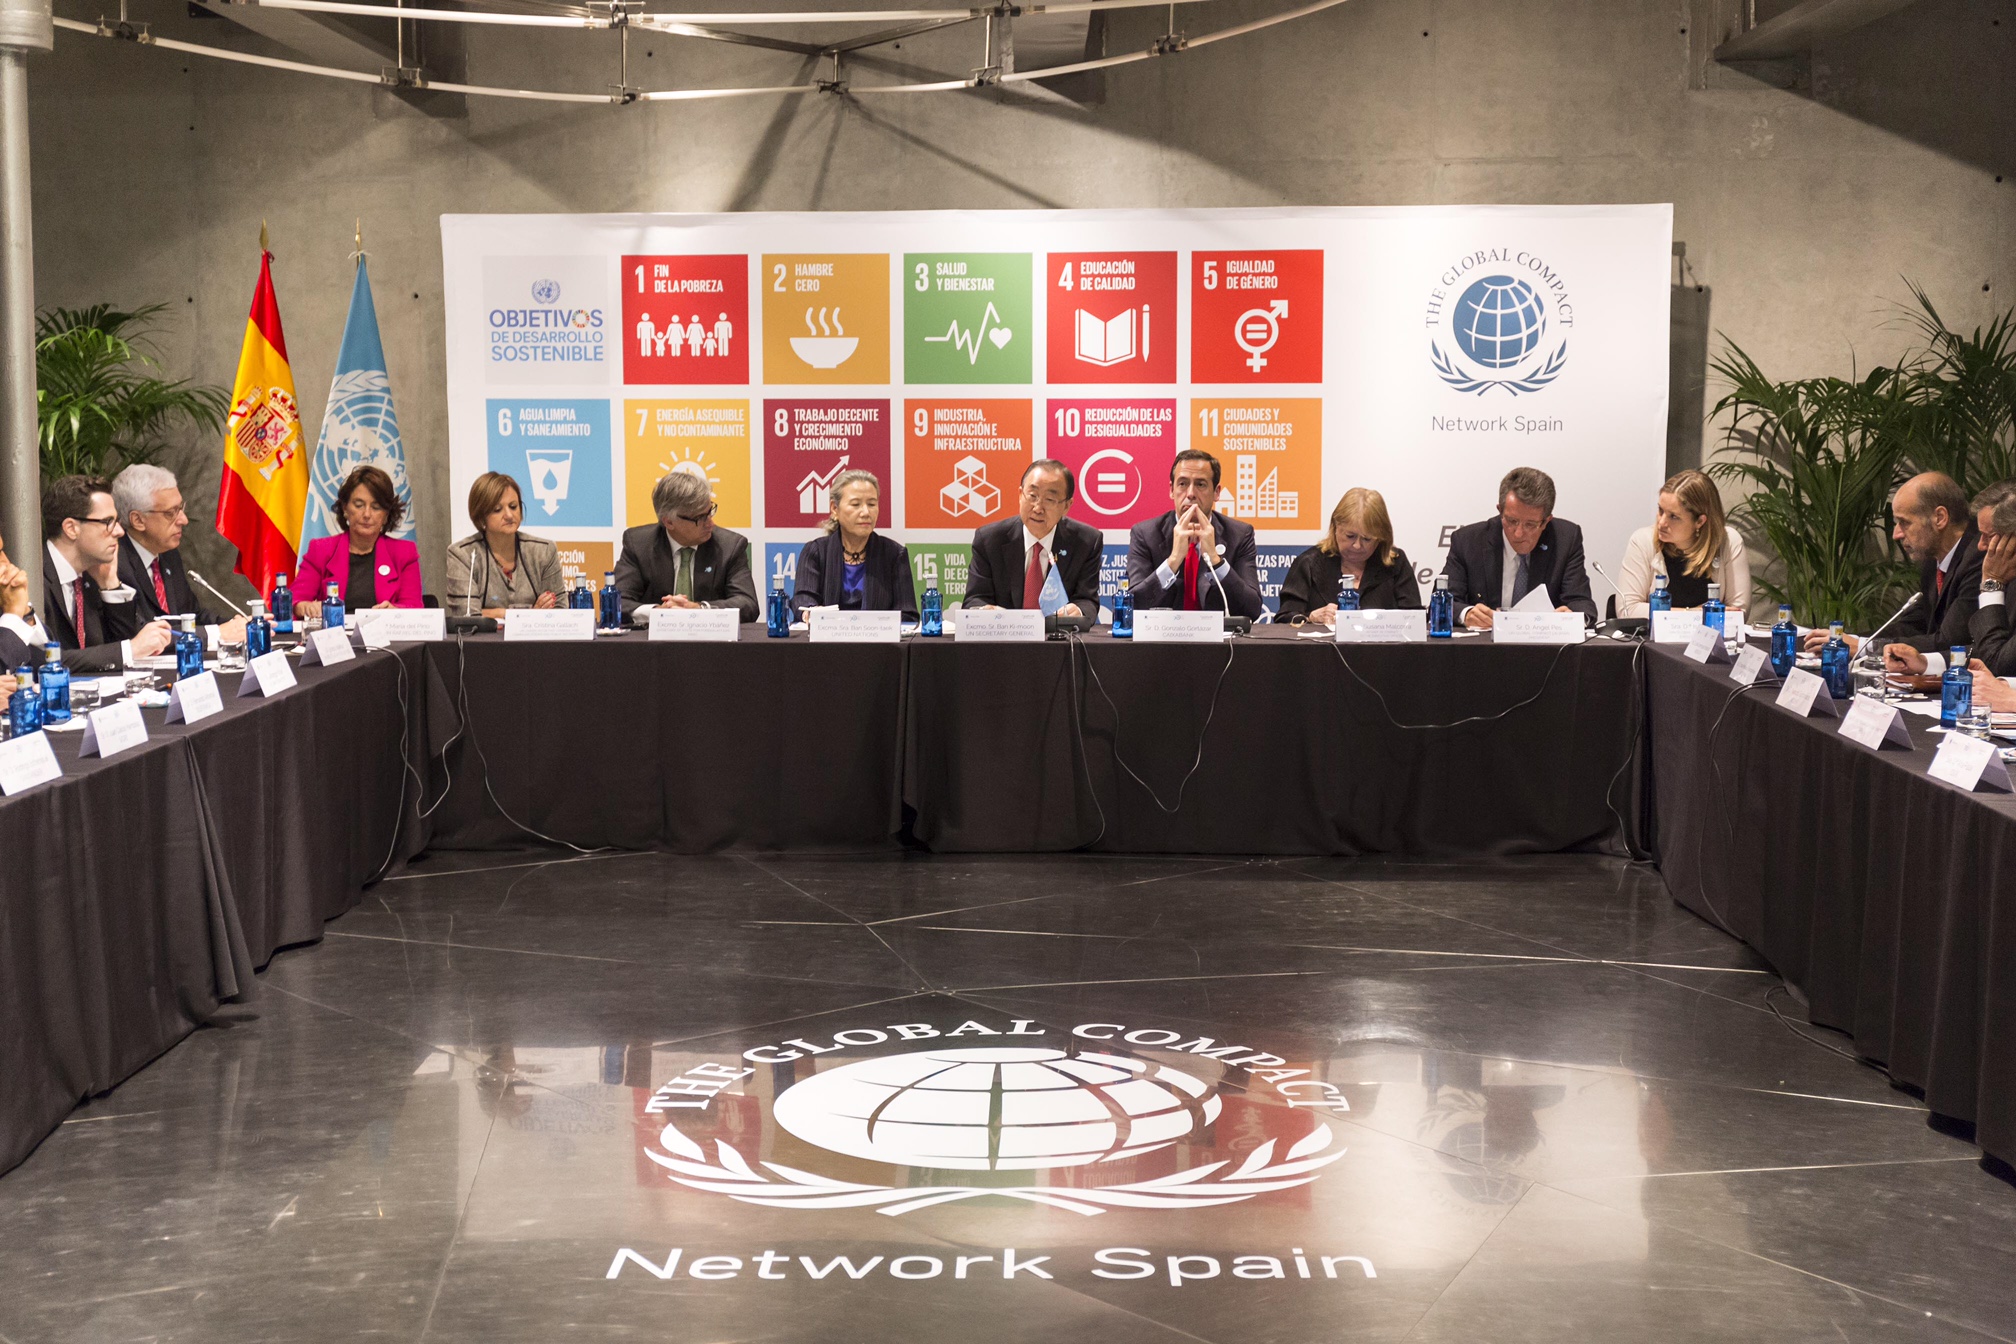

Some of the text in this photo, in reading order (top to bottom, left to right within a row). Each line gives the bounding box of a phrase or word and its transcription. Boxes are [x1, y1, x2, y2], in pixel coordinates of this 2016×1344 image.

[654, 265, 669, 277] FIN
[795, 263, 834, 276] HAMBRE
[936, 262, 967, 275] SALUD
[1080, 259, 1135, 275] EDUCACIÓN
[1227, 260, 1275, 274] IGUALDAD
[635, 265, 644, 293] 1
[773, 264, 786, 292] 2
[915, 263, 929, 292] 3
[1058, 262, 1074, 290] 4
[1203, 261, 1218, 290] 5
[1226, 274, 1278, 289] DE GÉNERO
[655, 280, 723, 293] DE LA POBREZA
[795, 279, 820, 292] CERO
[936, 278, 994, 291] Y BIENESTAR
[1080, 277, 1135, 291] DE CALIDAD
[1426, 248, 1573, 328] THE GLOBAL COMPACT
[489, 309, 603, 328] OBJETIVOS
[491, 331, 603, 343] DE DESARROLLO
[491, 346, 603, 361] SOSTENIBLE
[519, 408, 576, 421] AGUA LIMPIA
[657, 407, 744, 421] ENERGÍA ASEQUIBLE
[794, 409, 879, 421] TRABAJO DECENTE
[934, 409, 986, 422] INDUSTRIA,
[1085, 406, 1172, 421] REDUCCIÓN DE LAS
[1224, 408, 1280, 421] CIUDADES Y
[498, 408, 512, 436] 6
[636, 409, 648, 437] 7
[774, 408, 789, 437] 8
[914, 408, 928, 437] 9
[934, 421, 997, 436] INNOVACIÓN E
[1054, 408, 1080, 437] 10
[1199, 408, 1218, 437] 11
[1432, 415, 1563, 435] Network Spain
[520, 423, 590, 436] Y SANEAMIENTO
[657, 424, 745, 437] Y NO CONTAMINANTE
[794, 423, 862, 436] Y CRECIMIENTO
[1085, 424, 1162, 437] DESIGUALDADES
[1224, 423, 1292, 436] COMUNIDADES
[794, 436, 848, 450] ECONÓMICO
[934, 438, 1021, 451] INFRAESTRUCTURA
[1224, 438, 1286, 451] SOSTENIBLES
[773, 552, 796, 580] 14
[944, 553, 966, 566] VIDA
[914, 553, 938, 581] 15
[944, 568, 956, 580] DE
[644, 1062, 756, 1113] THE
[743, 1020, 1046, 1063] GLOBAL
[1072, 1023, 1351, 1112] COMPACT
[605, 1247, 1378, 1287] Network Spain
